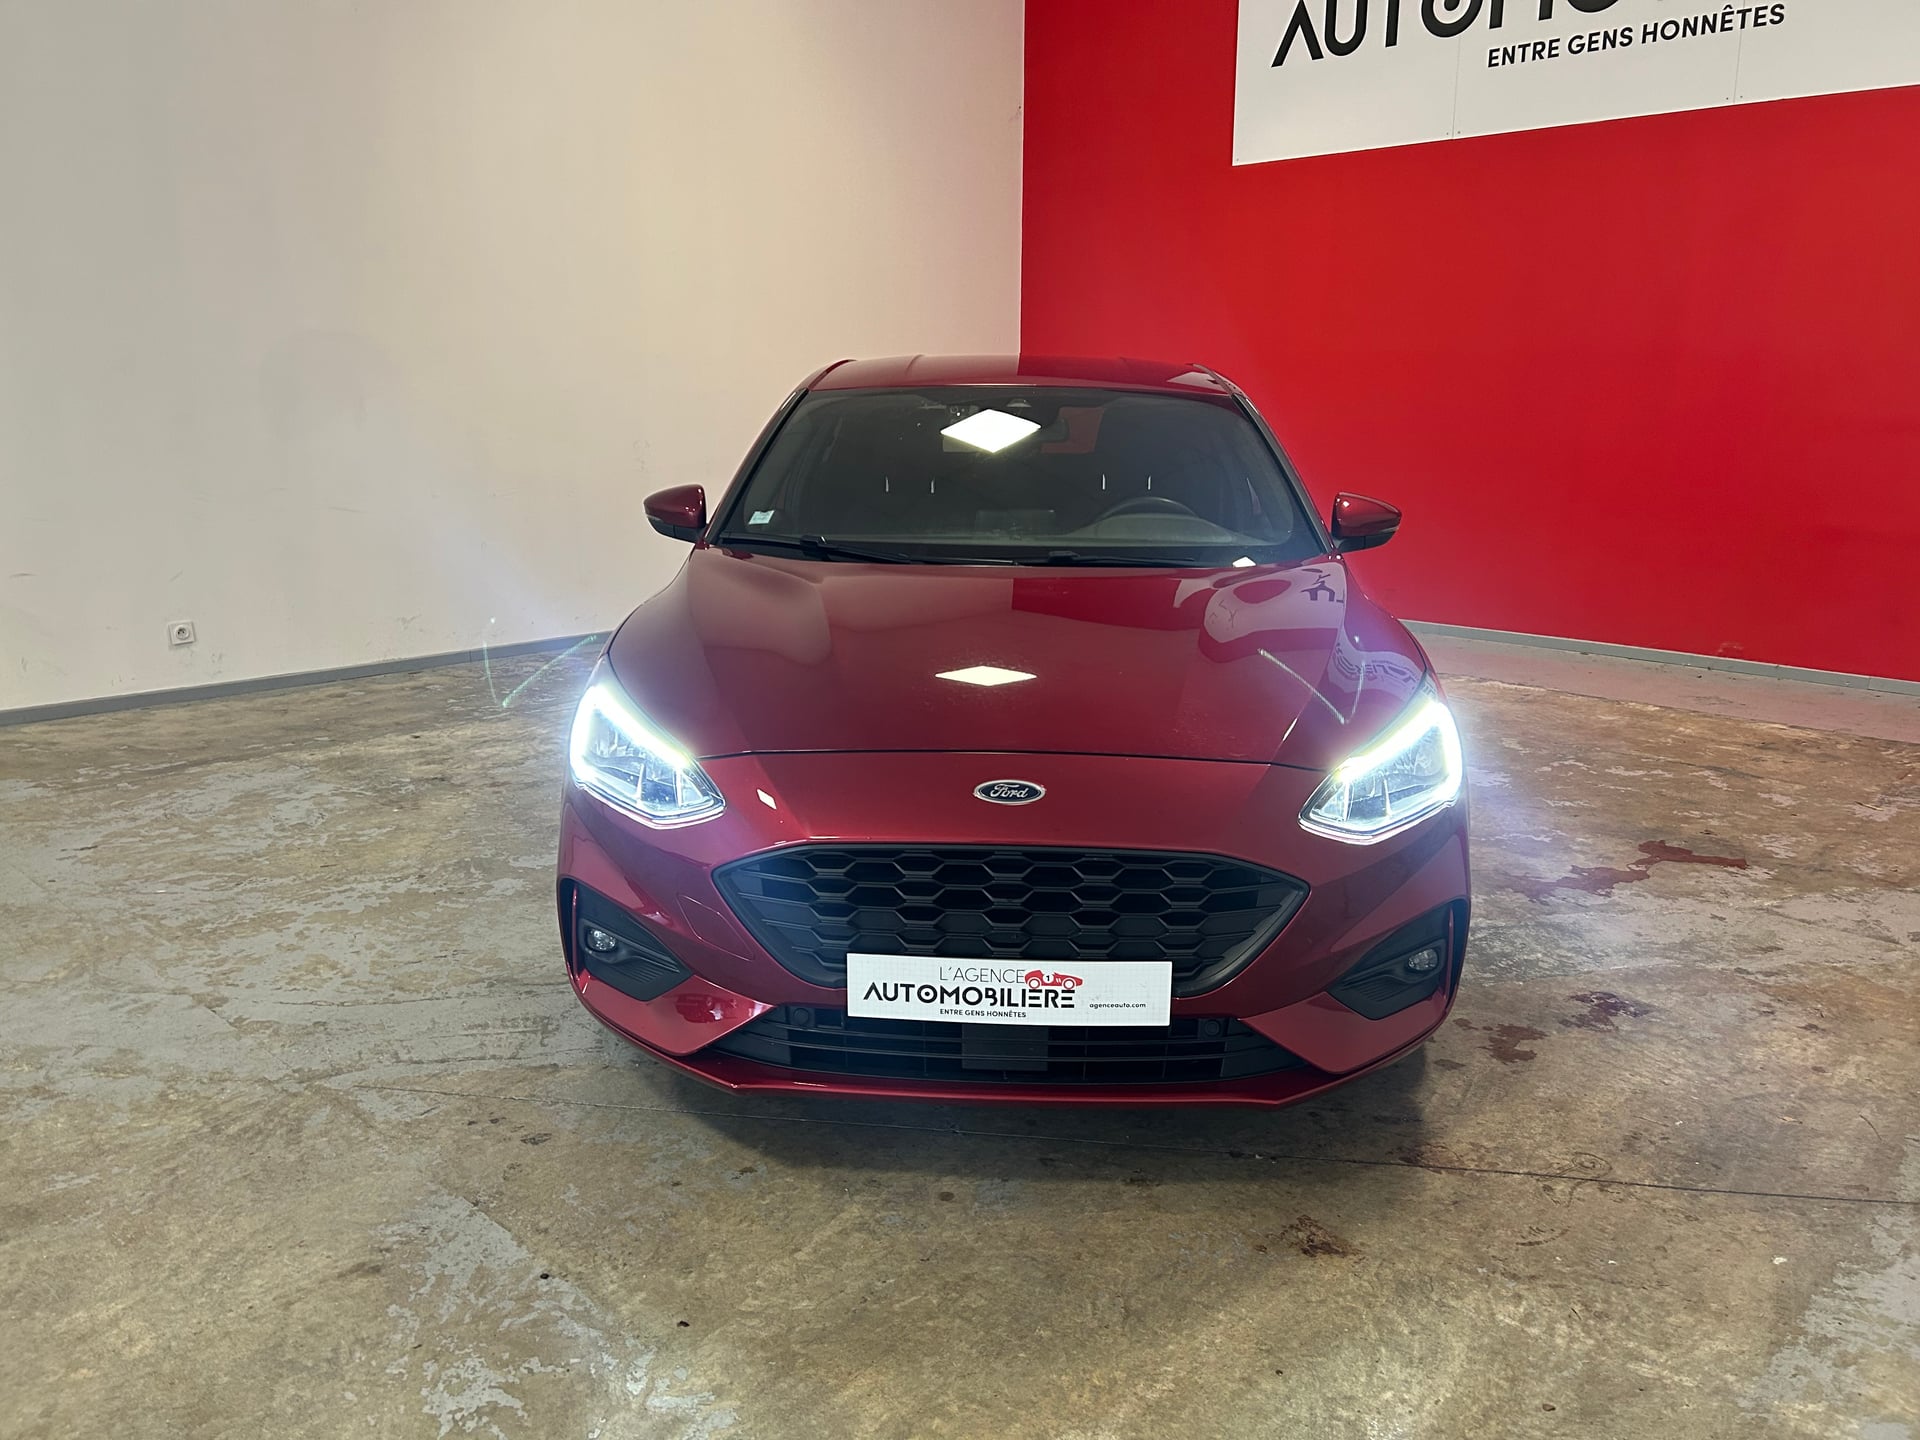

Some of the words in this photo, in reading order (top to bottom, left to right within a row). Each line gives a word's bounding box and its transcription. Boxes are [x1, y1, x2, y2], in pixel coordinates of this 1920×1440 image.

[1487, 38, 1561, 68] ENTRE
[1567, 26, 1633, 55] GENS
[1641, 3, 1785, 44] HONNÊTES
[990, 783, 1029, 798] Ford
[939, 966, 1025, 984] L'AGENCE
[939, 1008, 963, 1016] ENTRE
[964, 1009, 985, 1017] GENS
[986, 1010, 1027, 1018] HONNÊTES
[1089, 1002, 1147, 1010] agenceauto.com
